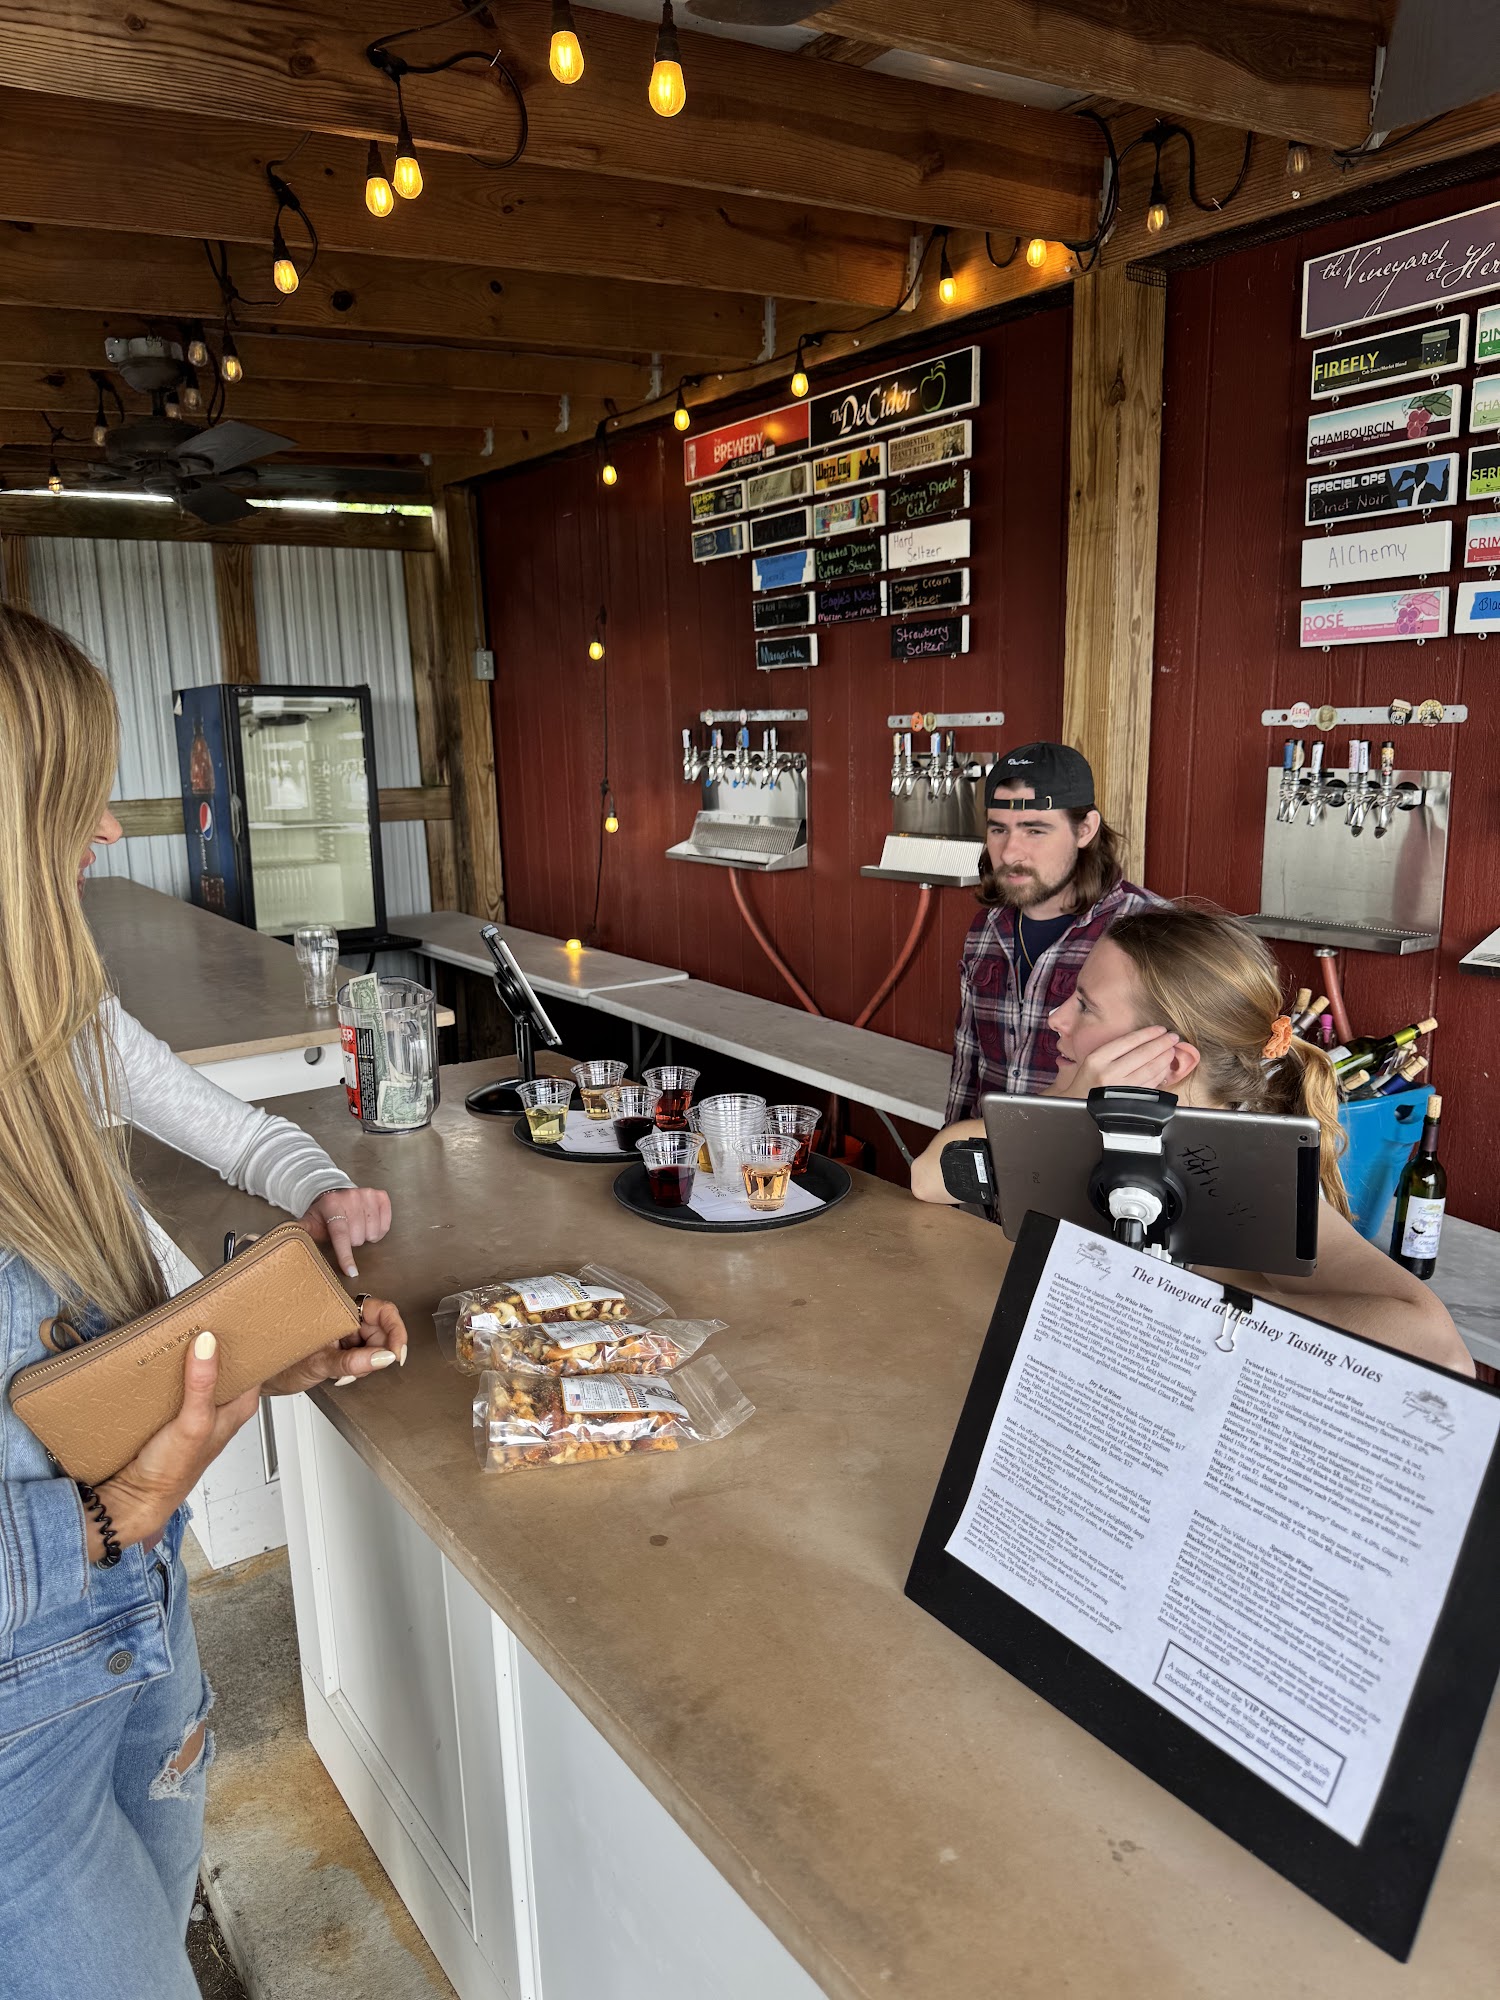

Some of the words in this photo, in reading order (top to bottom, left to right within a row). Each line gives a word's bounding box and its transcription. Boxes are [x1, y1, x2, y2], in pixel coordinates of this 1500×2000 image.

[1320, 254, 1345, 280] the
[1343, 240, 1450, 318] Vineyard
[1425, 260, 1453, 282] at
[1314, 351, 1380, 381] FIREFLY
[839, 381, 918, 435] DeCider
[891, 435, 929, 450] PRESIDENTIAL
[1310, 420, 1395, 446] CHAMBOURCIN
[713, 433, 764, 463] BREWERY
[891, 448, 912, 460] PEANUT
[913, 443, 935, 456] BUTTER
[1361, 472, 1386, 486] OPS
[890, 488, 927, 507] Johnny
[929, 477, 957, 496] Apple
[906, 499, 940, 517] Cider
[1311, 498, 1353, 519] Pinot
[1356, 493, 1389, 511] Noir
[893, 532, 914, 549] Hard
[907, 546, 941, 563] Seltzer
[818, 565, 843, 579] Coffee
[848, 559, 873, 573] Stout
[922, 576, 951, 589] Cream
[820, 591, 850, 611] Eagle's
[854, 589, 877, 601] Nest
[902, 594, 941, 610] Seltzer
[1478, 596, 1500, 612] Bla
[1303, 610, 1344, 631] ROSÉ
[896, 625, 950, 643] Strawberry
[760, 645, 805, 666] Margarita
[906, 641, 944, 656] Seltzer
[1132, 1265, 1154, 1284] The
[1156, 1276, 1212, 1308] Vineyard
[1212, 1303, 1227, 1316] at
[1228, 1308, 1283, 1342] Hershey
[1286, 1331, 1337, 1366] Tasting
[1338, 1354, 1382, 1382] Notes
[1088, 1379, 1098, 1388] Dry
[1097, 1384, 1108, 1392] Red
[1107, 1388, 1121, 1400] Wines
[1327, 1387, 1345, 1399] Sweet
[1345, 1394, 1363, 1407] Wines
[1196, 1668, 1210, 1682] Ask
[1210, 1678, 1230, 1695] about
[1230, 1691, 1242, 1703] the
[1244, 1698, 1259, 1713] VIP
[1259, 1709, 1305, 1745] Experience!
[1167, 1661, 1173, 1670] A
[1174, 1666, 1215, 1697] semi-private
[1215, 1694, 1230, 1708] tour
[1230, 1703, 1242, 1715] for
[1242, 1712, 1260, 1728] wine
[1260, 1726, 1269, 1734] or
[1269, 1731, 1286, 1746] beer
[1286, 1743, 1311, 1766] tasting
[1313, 1761, 1330, 1777] with
[1164, 1673, 1195, 1697] chocolate
[1195, 1693, 1203, 1702] &
[1203, 1700, 1226, 1719] cheese
[1225, 1716, 1255, 1739] pairings
[1255, 1737, 1270, 1749] and
[1269, 1747, 1302, 1771] souvenir
[1301, 1769, 1326, 1788] glass!
